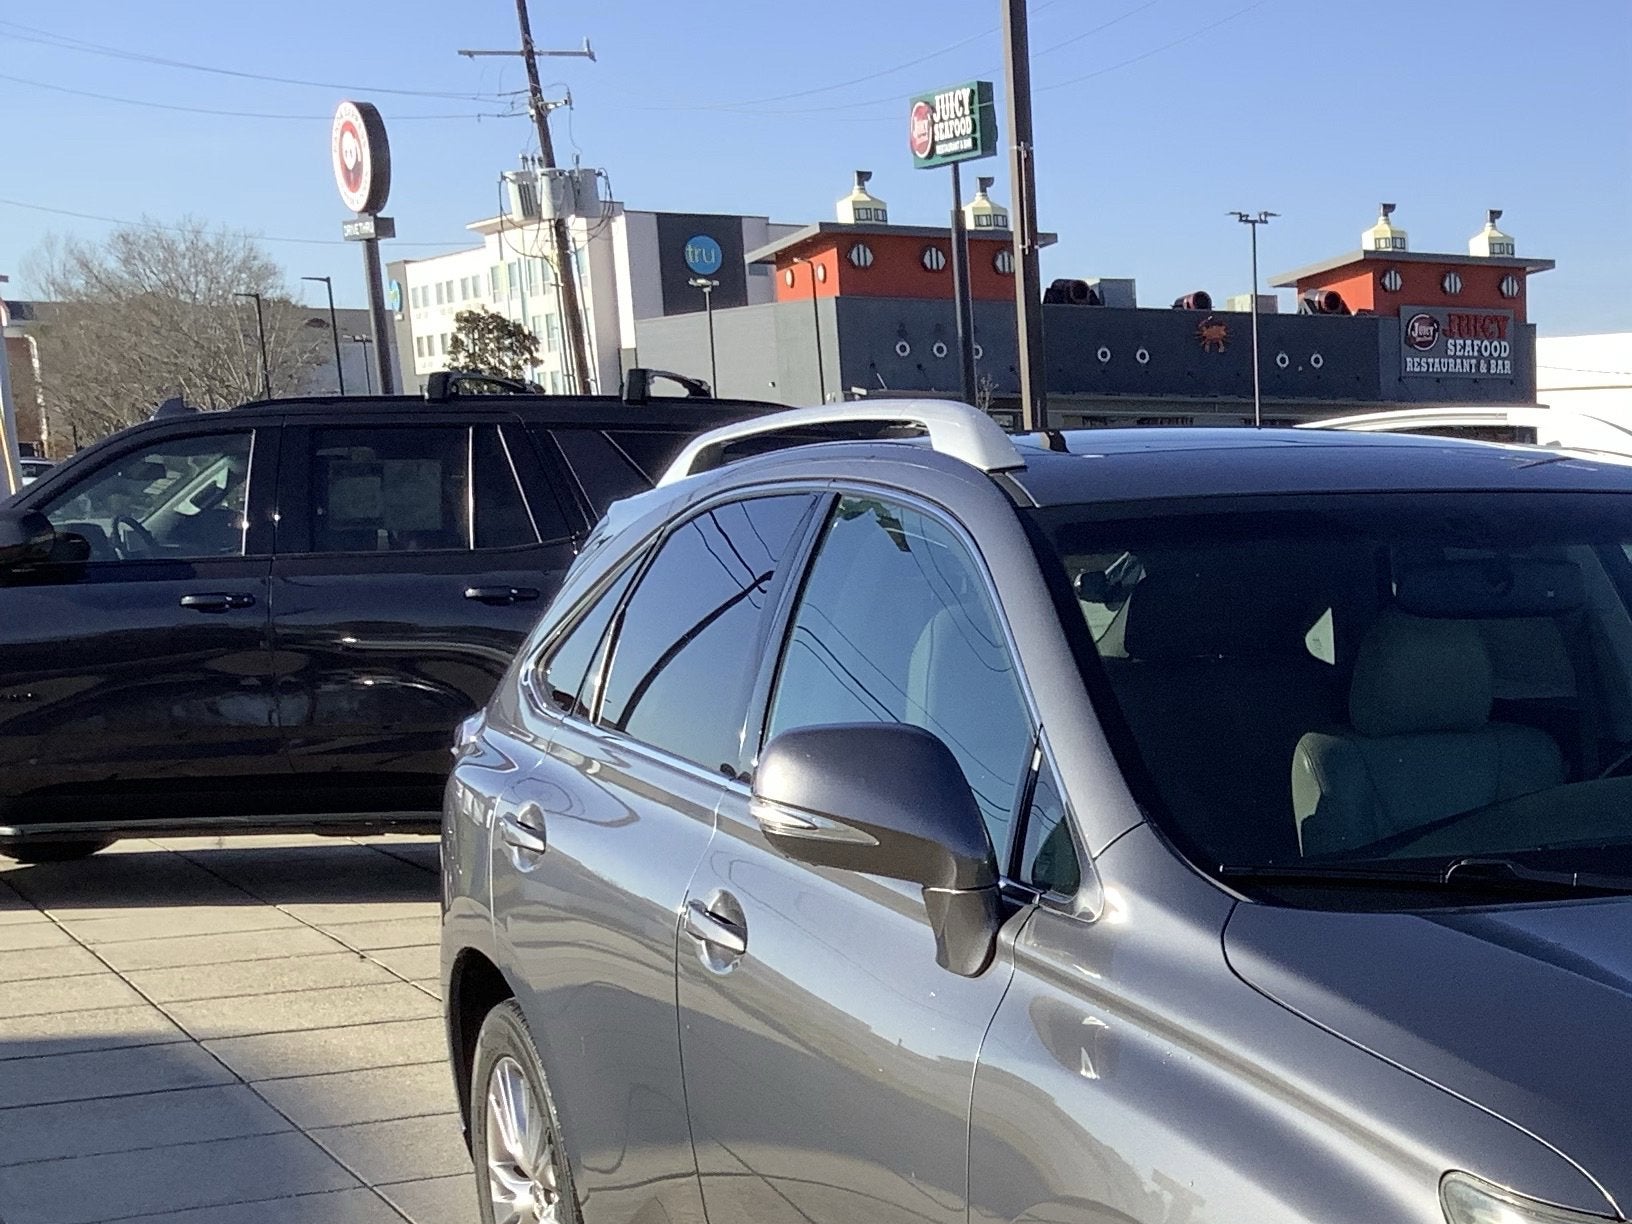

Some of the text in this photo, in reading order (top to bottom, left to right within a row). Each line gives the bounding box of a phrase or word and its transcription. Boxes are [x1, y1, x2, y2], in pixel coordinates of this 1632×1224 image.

[933, 88, 970, 122] JUICY
[934, 116, 972, 141] SEAFOOD
[686, 244, 715, 264] tru
[1442, 313, 1510, 338] JUICY
[1447, 339, 1510, 357] SEAFOOD
[1406, 357, 1512, 374] RESTAURANT & BAR
